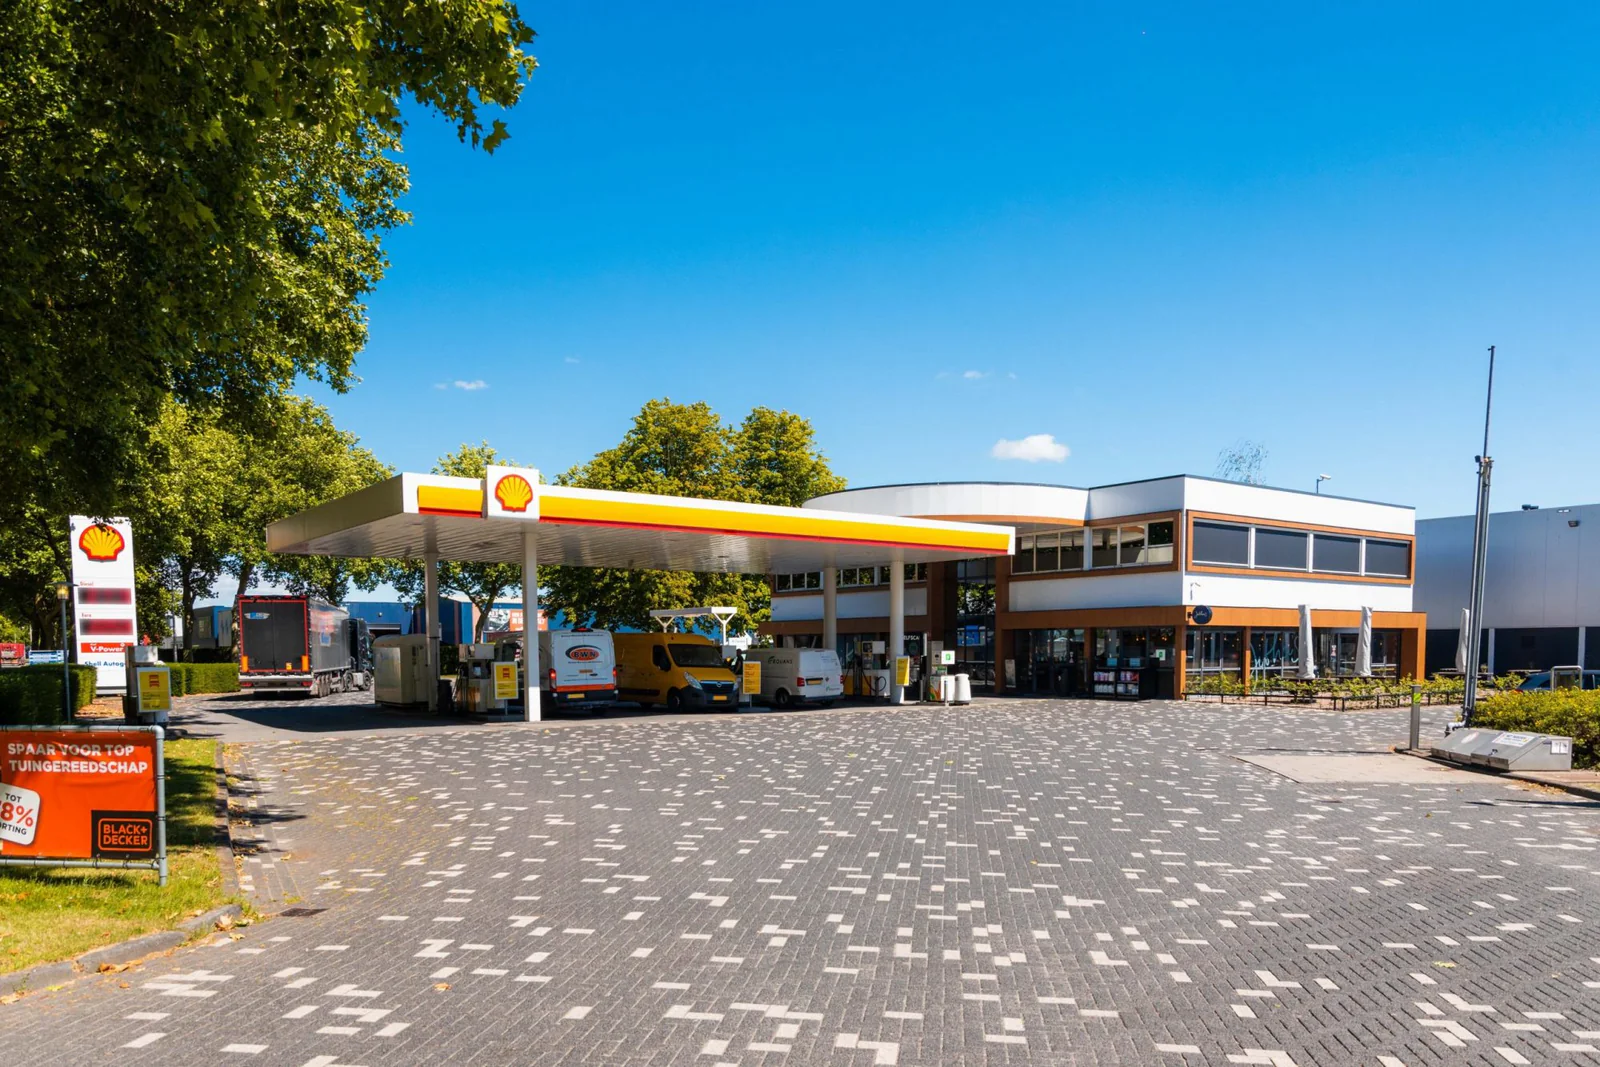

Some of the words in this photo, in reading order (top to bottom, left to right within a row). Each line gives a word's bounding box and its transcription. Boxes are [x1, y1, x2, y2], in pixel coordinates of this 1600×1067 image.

[90, 645, 124, 653] V-Power
[8, 743, 55, 756] SPAAR
[58, 744, 101, 757] VOOR
[105, 744, 134, 757] TOP
[9, 760, 148, 774] TUINGEREEDSCHAP
[5, 792, 22, 803] TOT
[0, 801, 34, 828] 8%
[0, 822, 27, 836] RTING
[103, 823, 148, 834] BLACK+
[103, 835, 148, 845] DECKER
